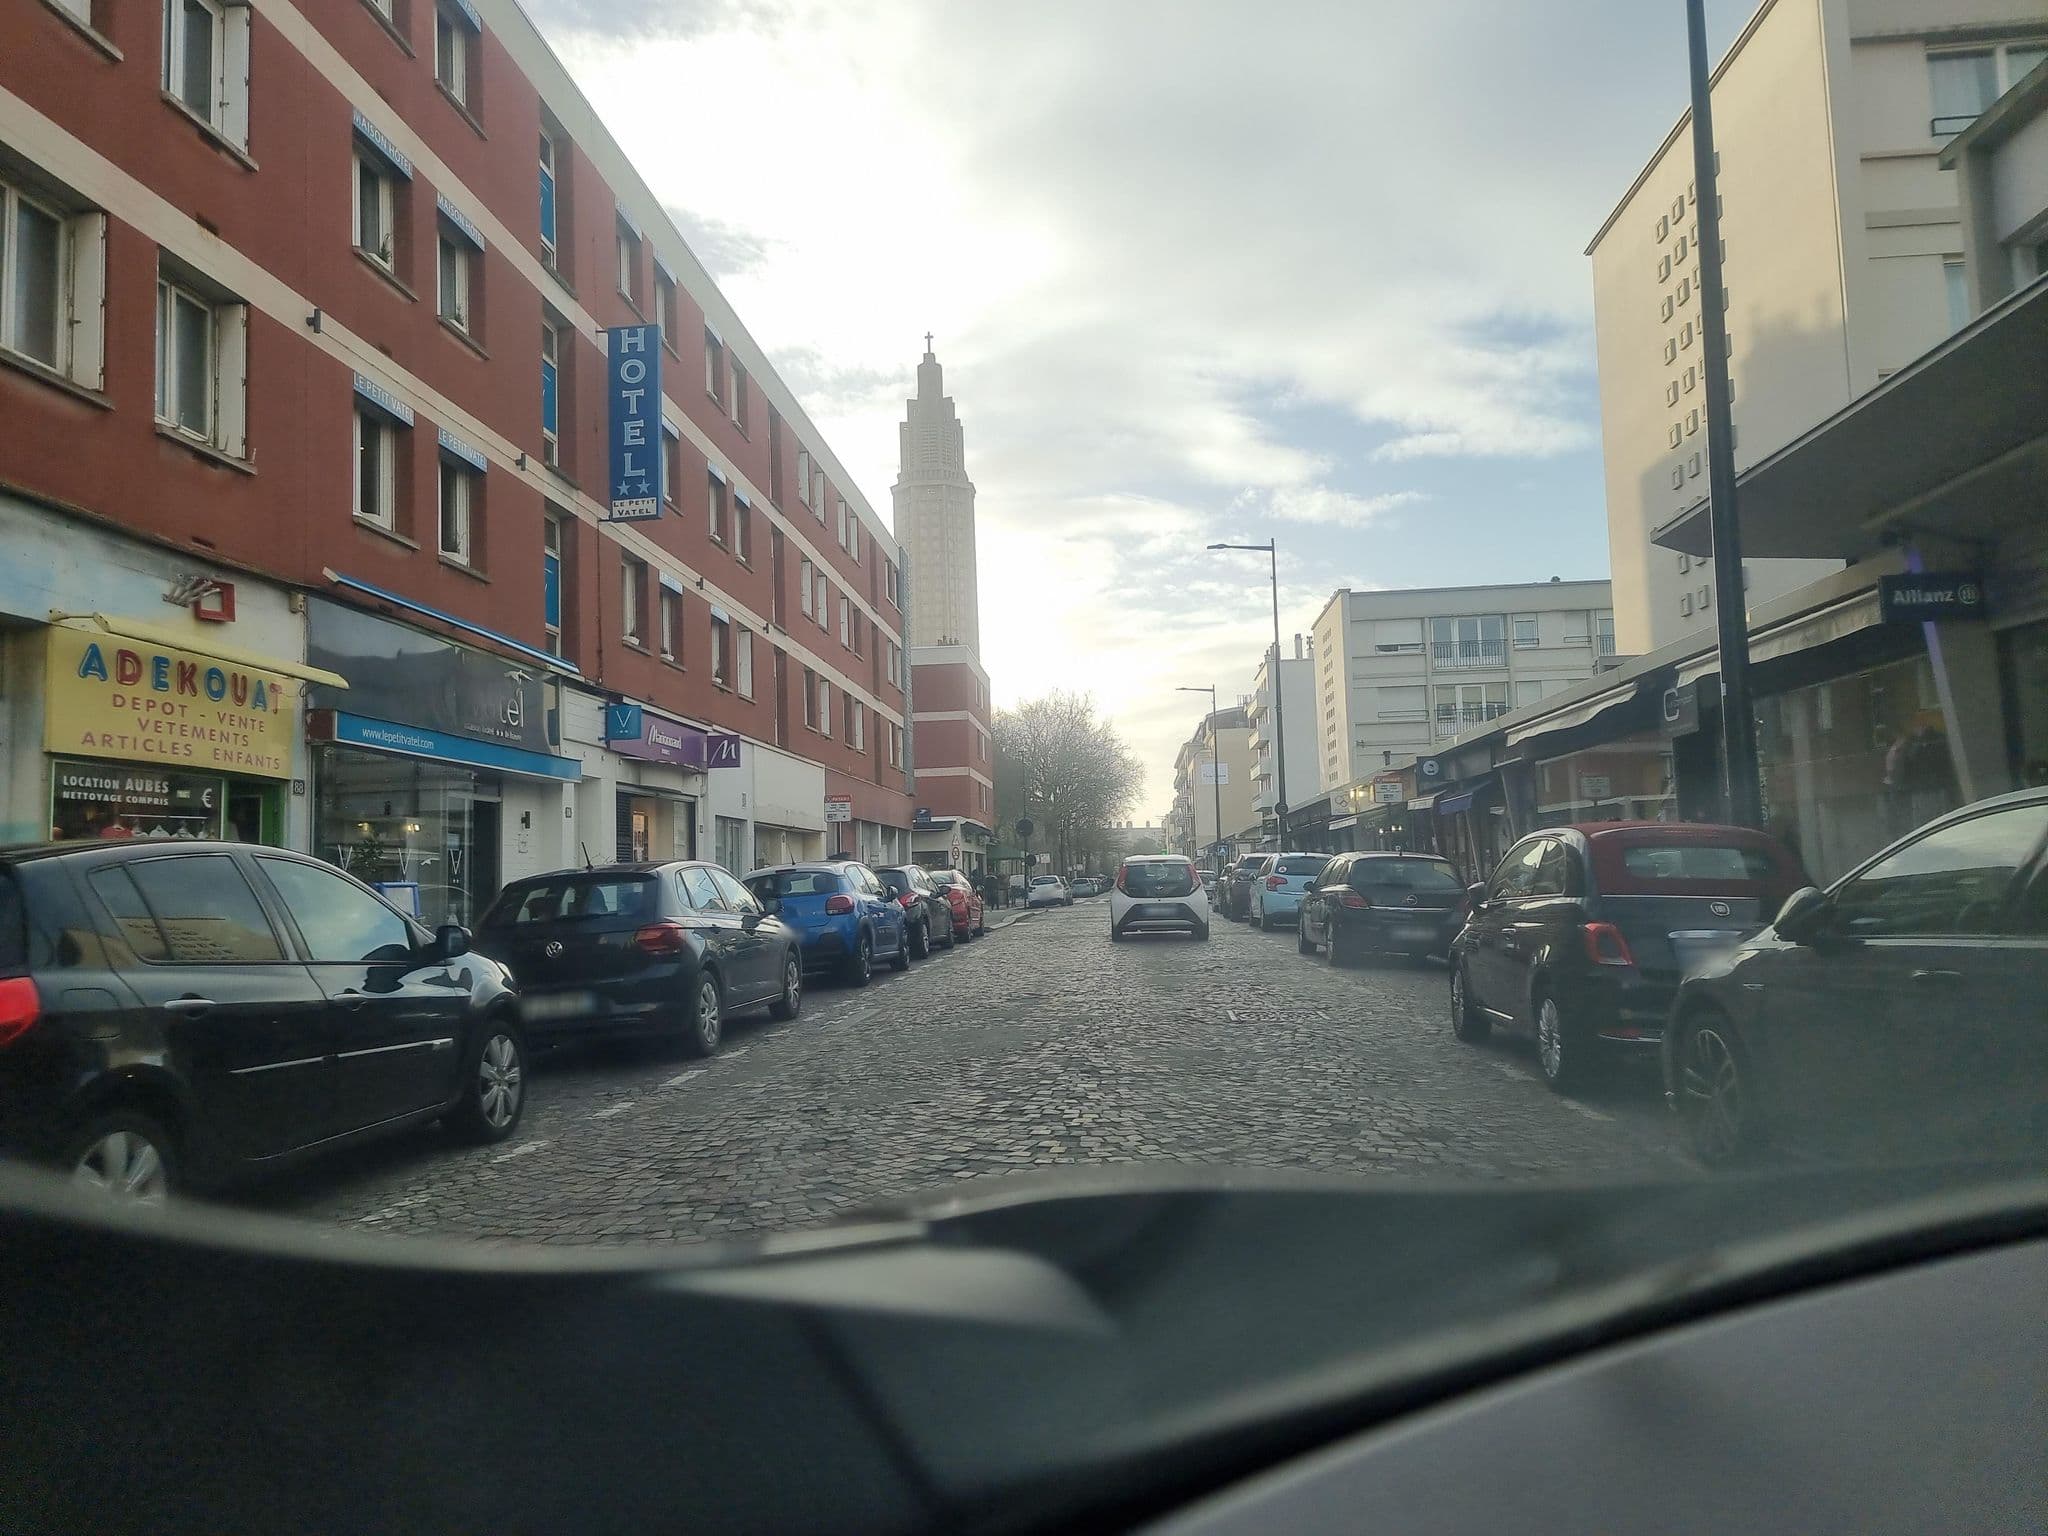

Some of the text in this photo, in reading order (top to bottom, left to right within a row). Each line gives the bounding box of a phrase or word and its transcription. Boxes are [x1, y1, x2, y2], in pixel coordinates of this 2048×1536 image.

[353, 110, 387, 150] MAISON
[437, 192, 465, 226] MAISON
[354, 371, 414, 421] LE PETIT VATEL
[620, 327, 646, 477] HOTEL
[438, 428, 447, 443] LE
[448, 435, 467, 456] PETIT
[617, 508, 652, 516] VATEL
[1893, 589, 1954, 603] Allianz
[78, 643, 282, 714] ADEKOUAT
[112, 694, 188, 718] DEPOT
[217, 712, 265, 733] VENTE
[137, 717, 249, 747] VETEMENTS
[362, 728, 434, 750] www.lepetitvatel.com
[81, 731, 281, 770] ARTICLES ENFANTS
[63, 775, 120, 789] LOCATION
[124, 777, 169, 794] AUBES
[63, 791, 168, 806] NETTOYAGE COMPRIS
